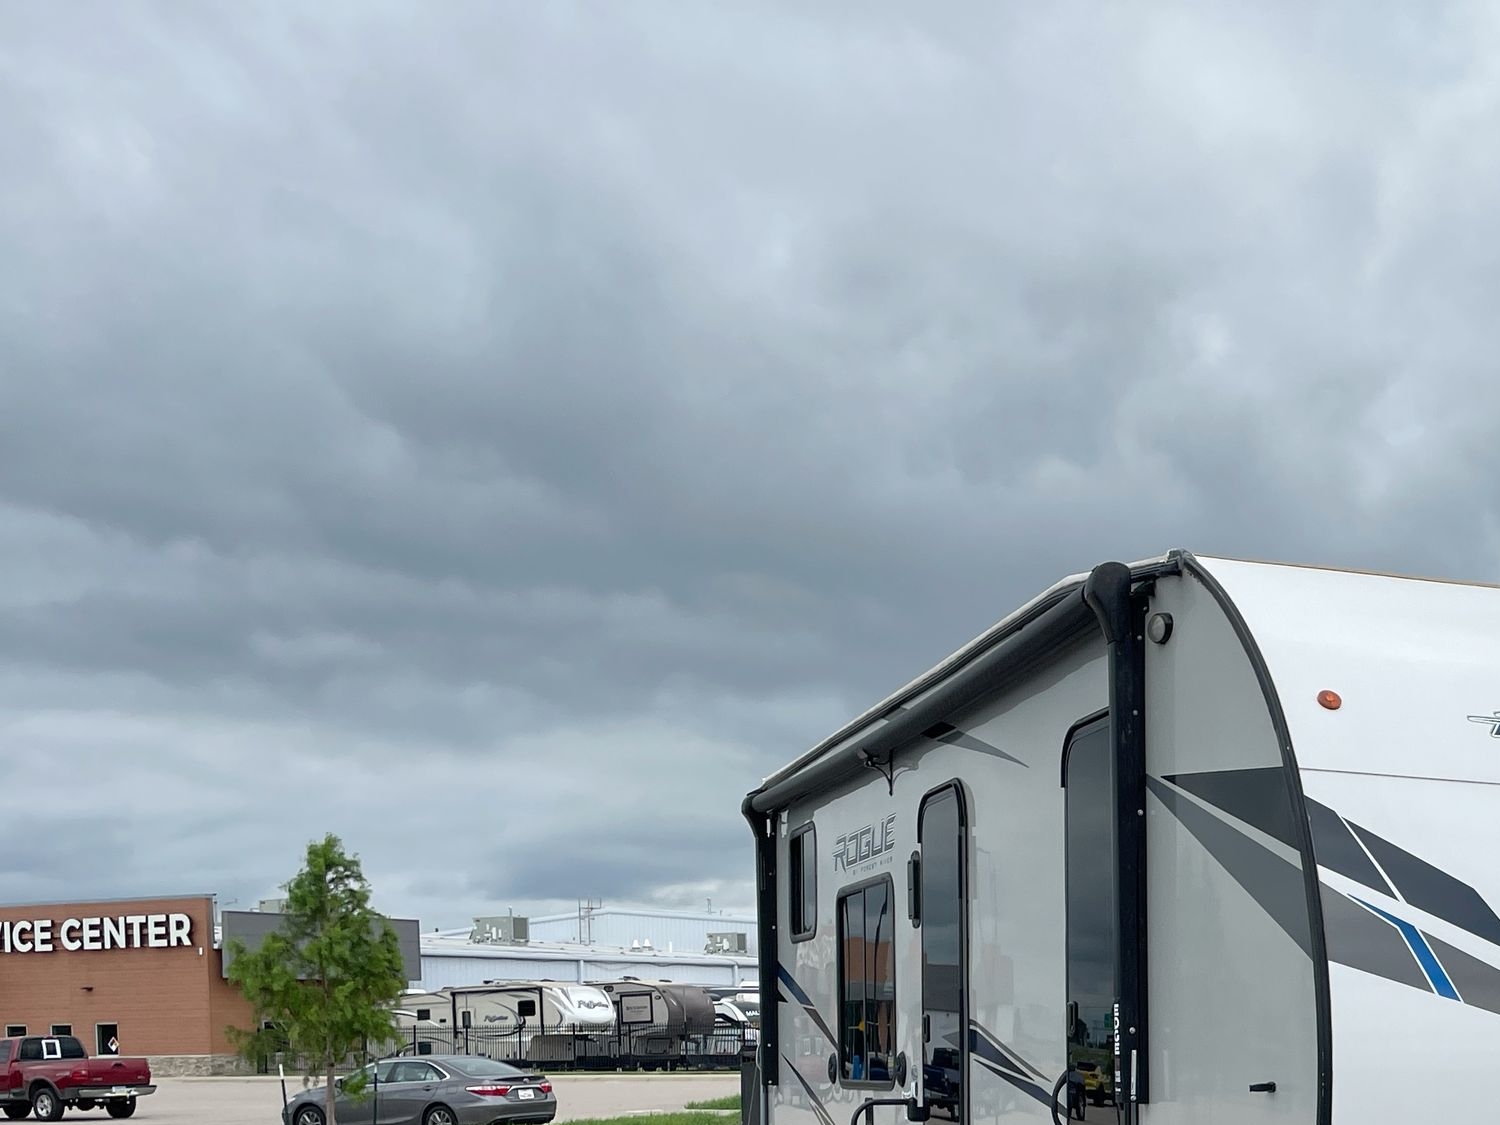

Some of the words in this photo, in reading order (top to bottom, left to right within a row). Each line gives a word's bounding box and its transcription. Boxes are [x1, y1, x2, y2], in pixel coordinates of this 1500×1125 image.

[832, 812, 897, 873] ROGUE
[0, 919, 53, 953] ICE
[60, 913, 192, 951] CENTER
